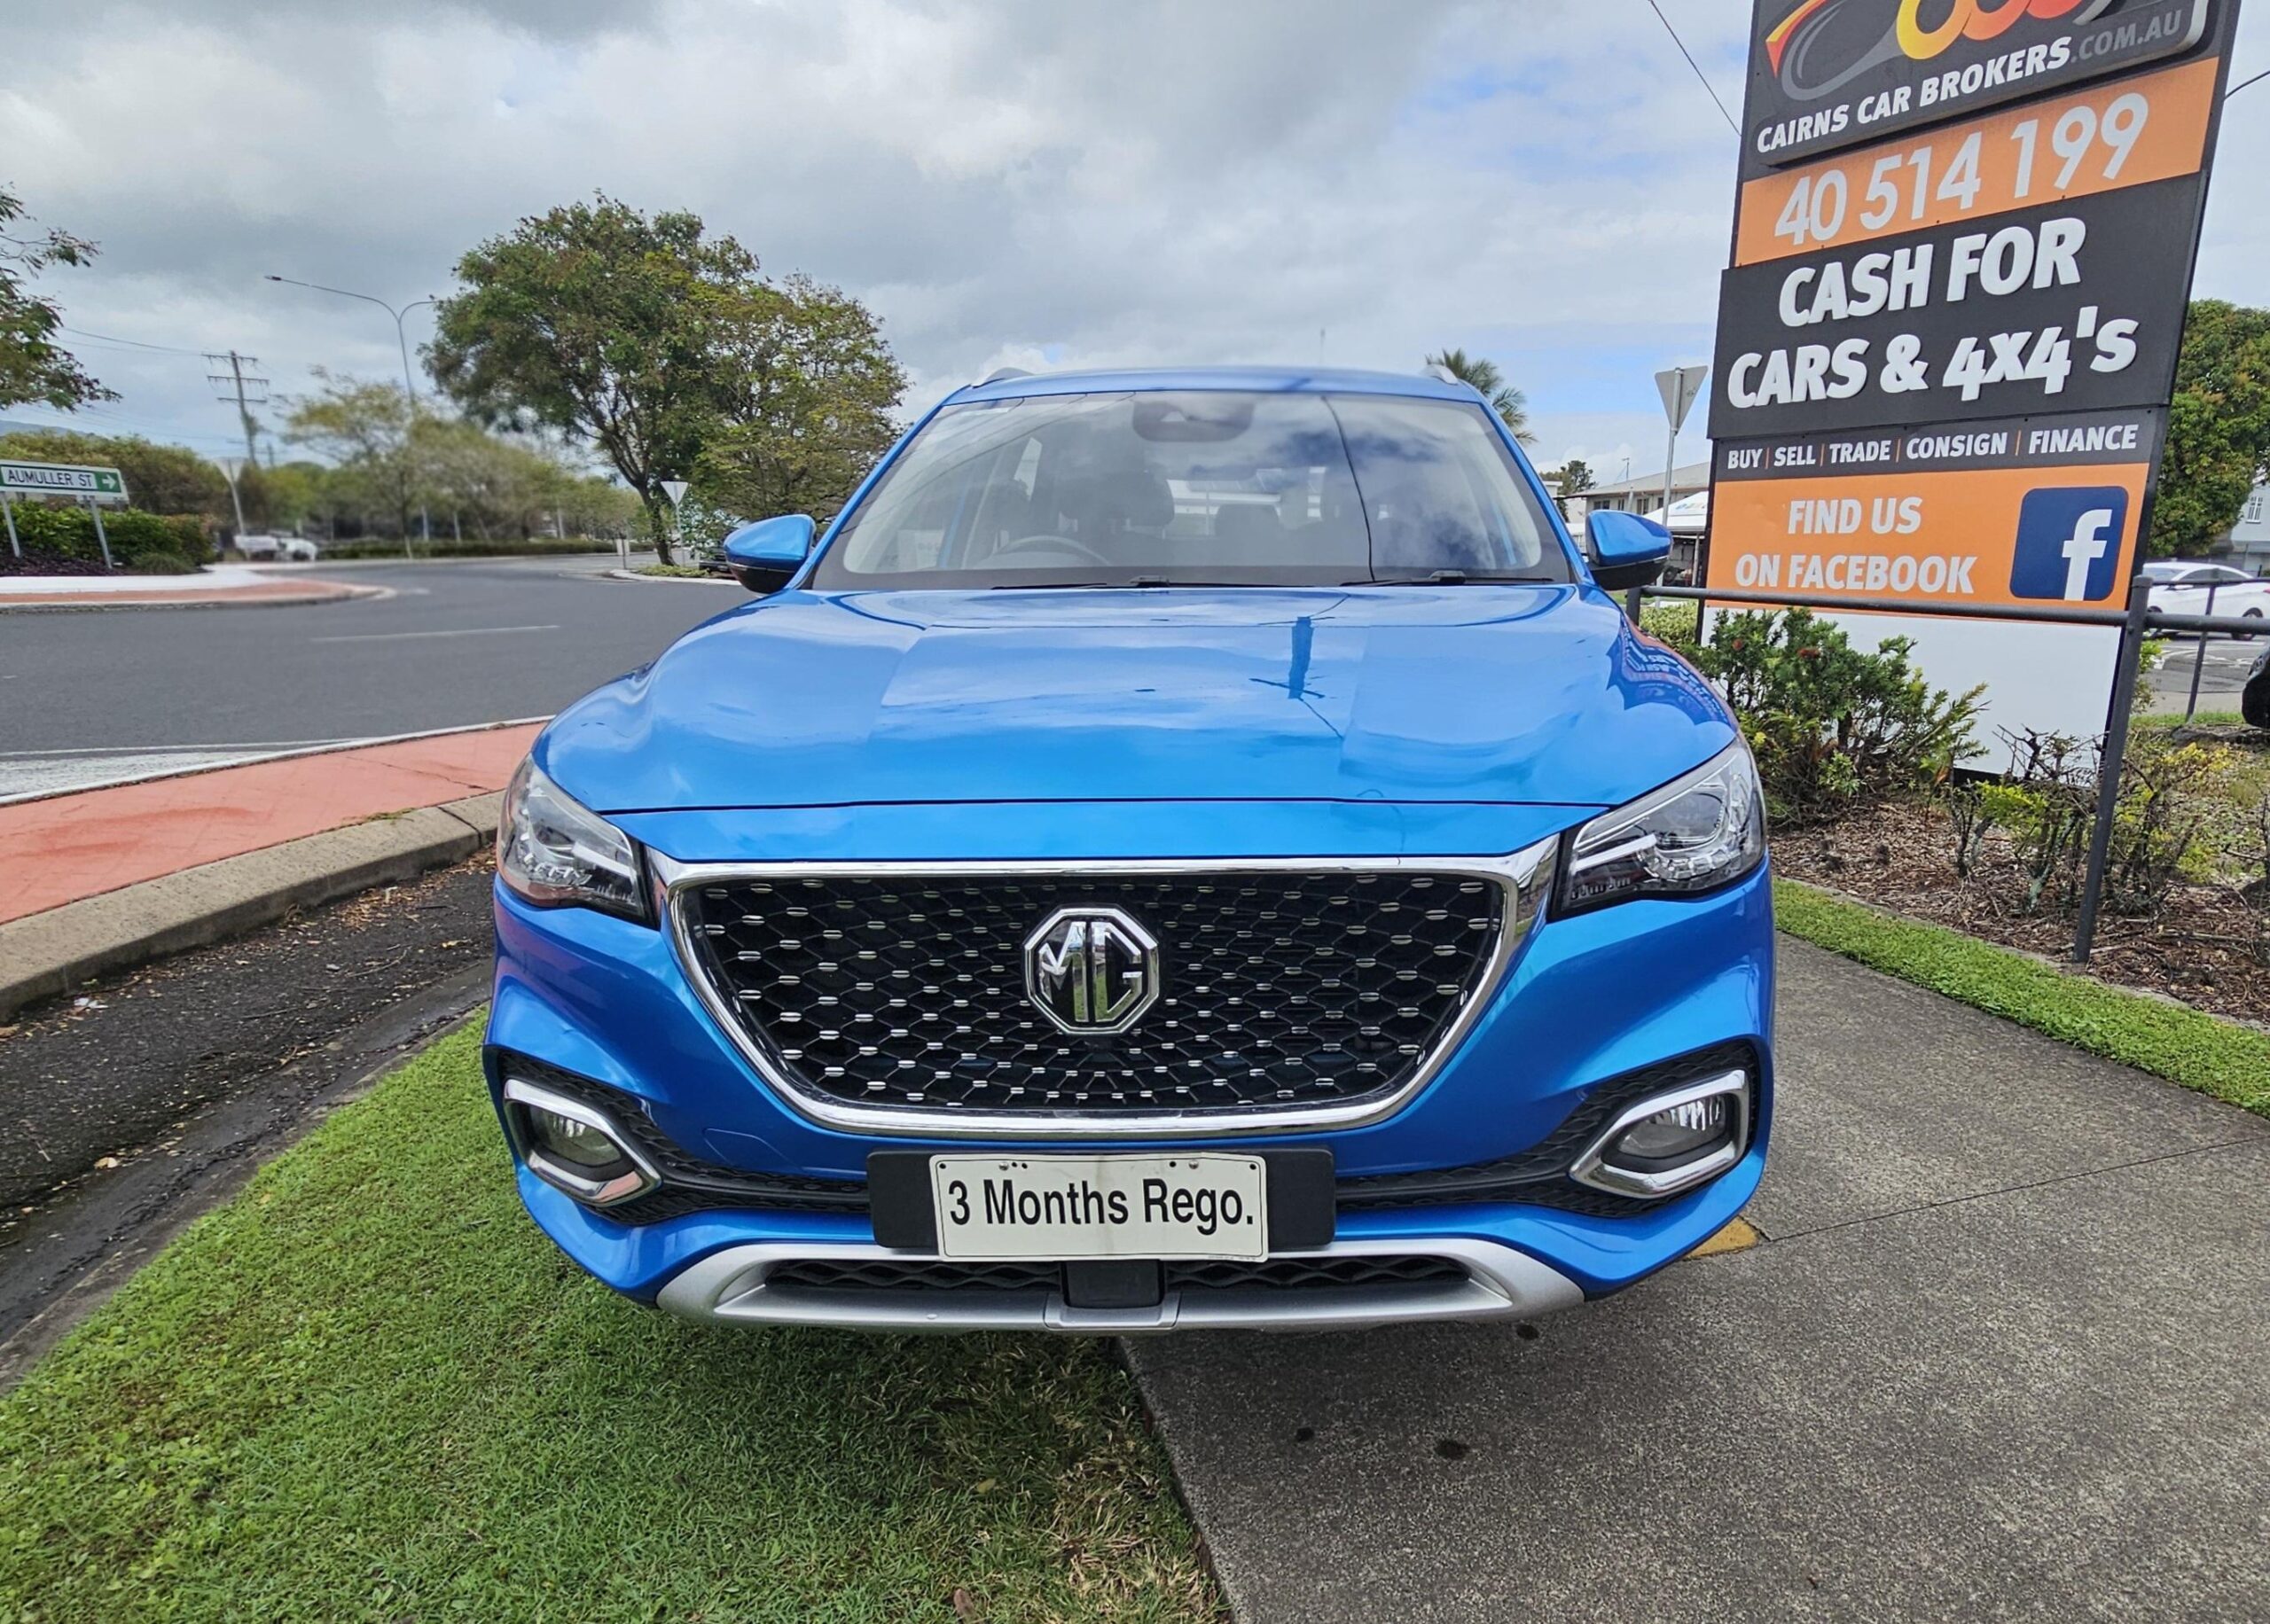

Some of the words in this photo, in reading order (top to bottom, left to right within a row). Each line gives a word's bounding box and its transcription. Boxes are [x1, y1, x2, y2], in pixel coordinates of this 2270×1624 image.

[1757, 104, 1850, 153] CAIRNS
[1858, 85, 1911, 124] CAR
[1774, 169, 1848, 246] 40
[1860, 131, 1983, 230] 514
[2011, 92, 2149, 199] 199
[1779, 243, 1934, 327] CASH
[1947, 217, 2087, 302] FOR
[1727, 339, 1870, 407] CARS
[1879, 334, 1929, 394] &
[8, 469, 74, 486] AUMULLER
[78, 472, 92, 487] ST
[1727, 449, 1763, 470] BUY
[1773, 445, 1816, 466] SELL
[1829, 441, 1891, 464] TRADE
[1906, 432, 2008, 460] CONSIGN
[2028, 424, 2139, 454] FINANCE
[1788, 500, 1862, 535] FIND
[1871, 496, 1922, 534] US
[1735, 554, 1781, 588] ON
[1788, 555, 1977, 594] FACEBOOK
[1037, 920, 1143, 1023] MG
[949, 1180, 971, 1226] 3
[983, 1178, 1129, 1226] Months
[1143, 1177, 1254, 1236] Rego.
